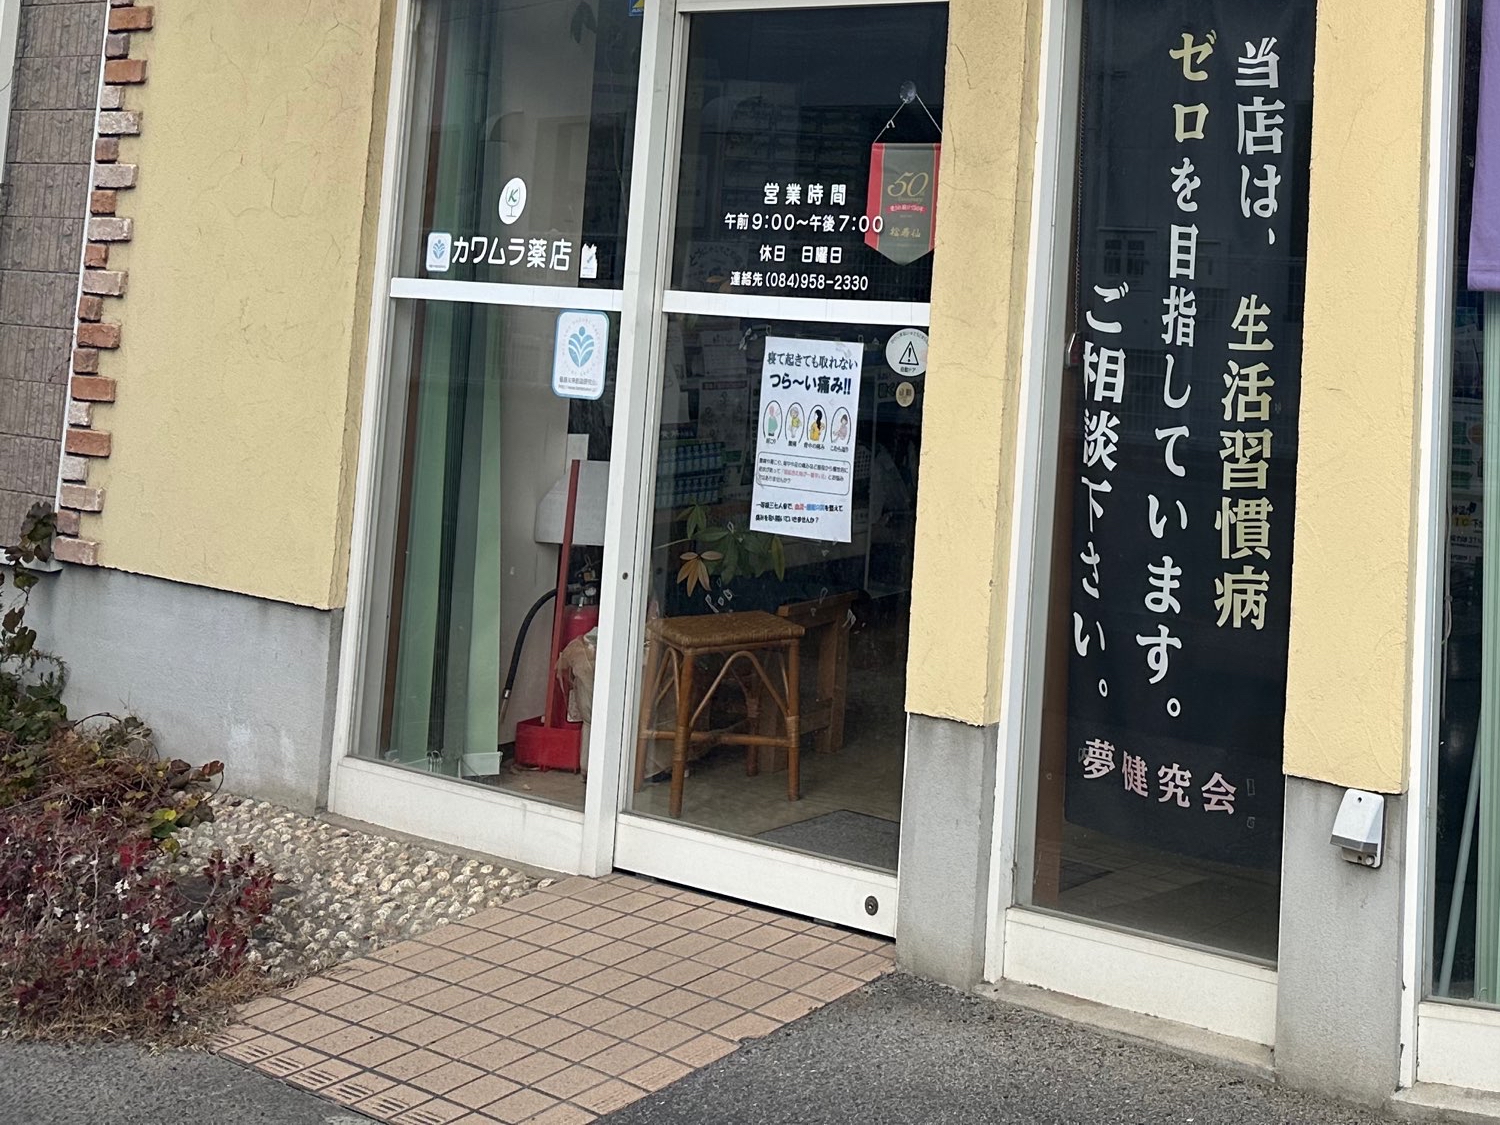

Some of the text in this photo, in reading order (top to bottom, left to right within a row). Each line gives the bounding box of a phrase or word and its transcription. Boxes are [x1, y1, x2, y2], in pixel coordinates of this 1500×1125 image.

[508, 188, 519, 203] K
[764, 183, 847, 206] 営業時間
[887, 172, 929, 197] 50
[452, 236, 572, 271] カワムラ薬店
[759, 245, 786, 262] 休日
[801, 246, 842, 264] 日曜日
[767, 351, 859, 371] 寝て起きても取れない
[1135, 30, 1217, 718] ゼロを目指しています。
